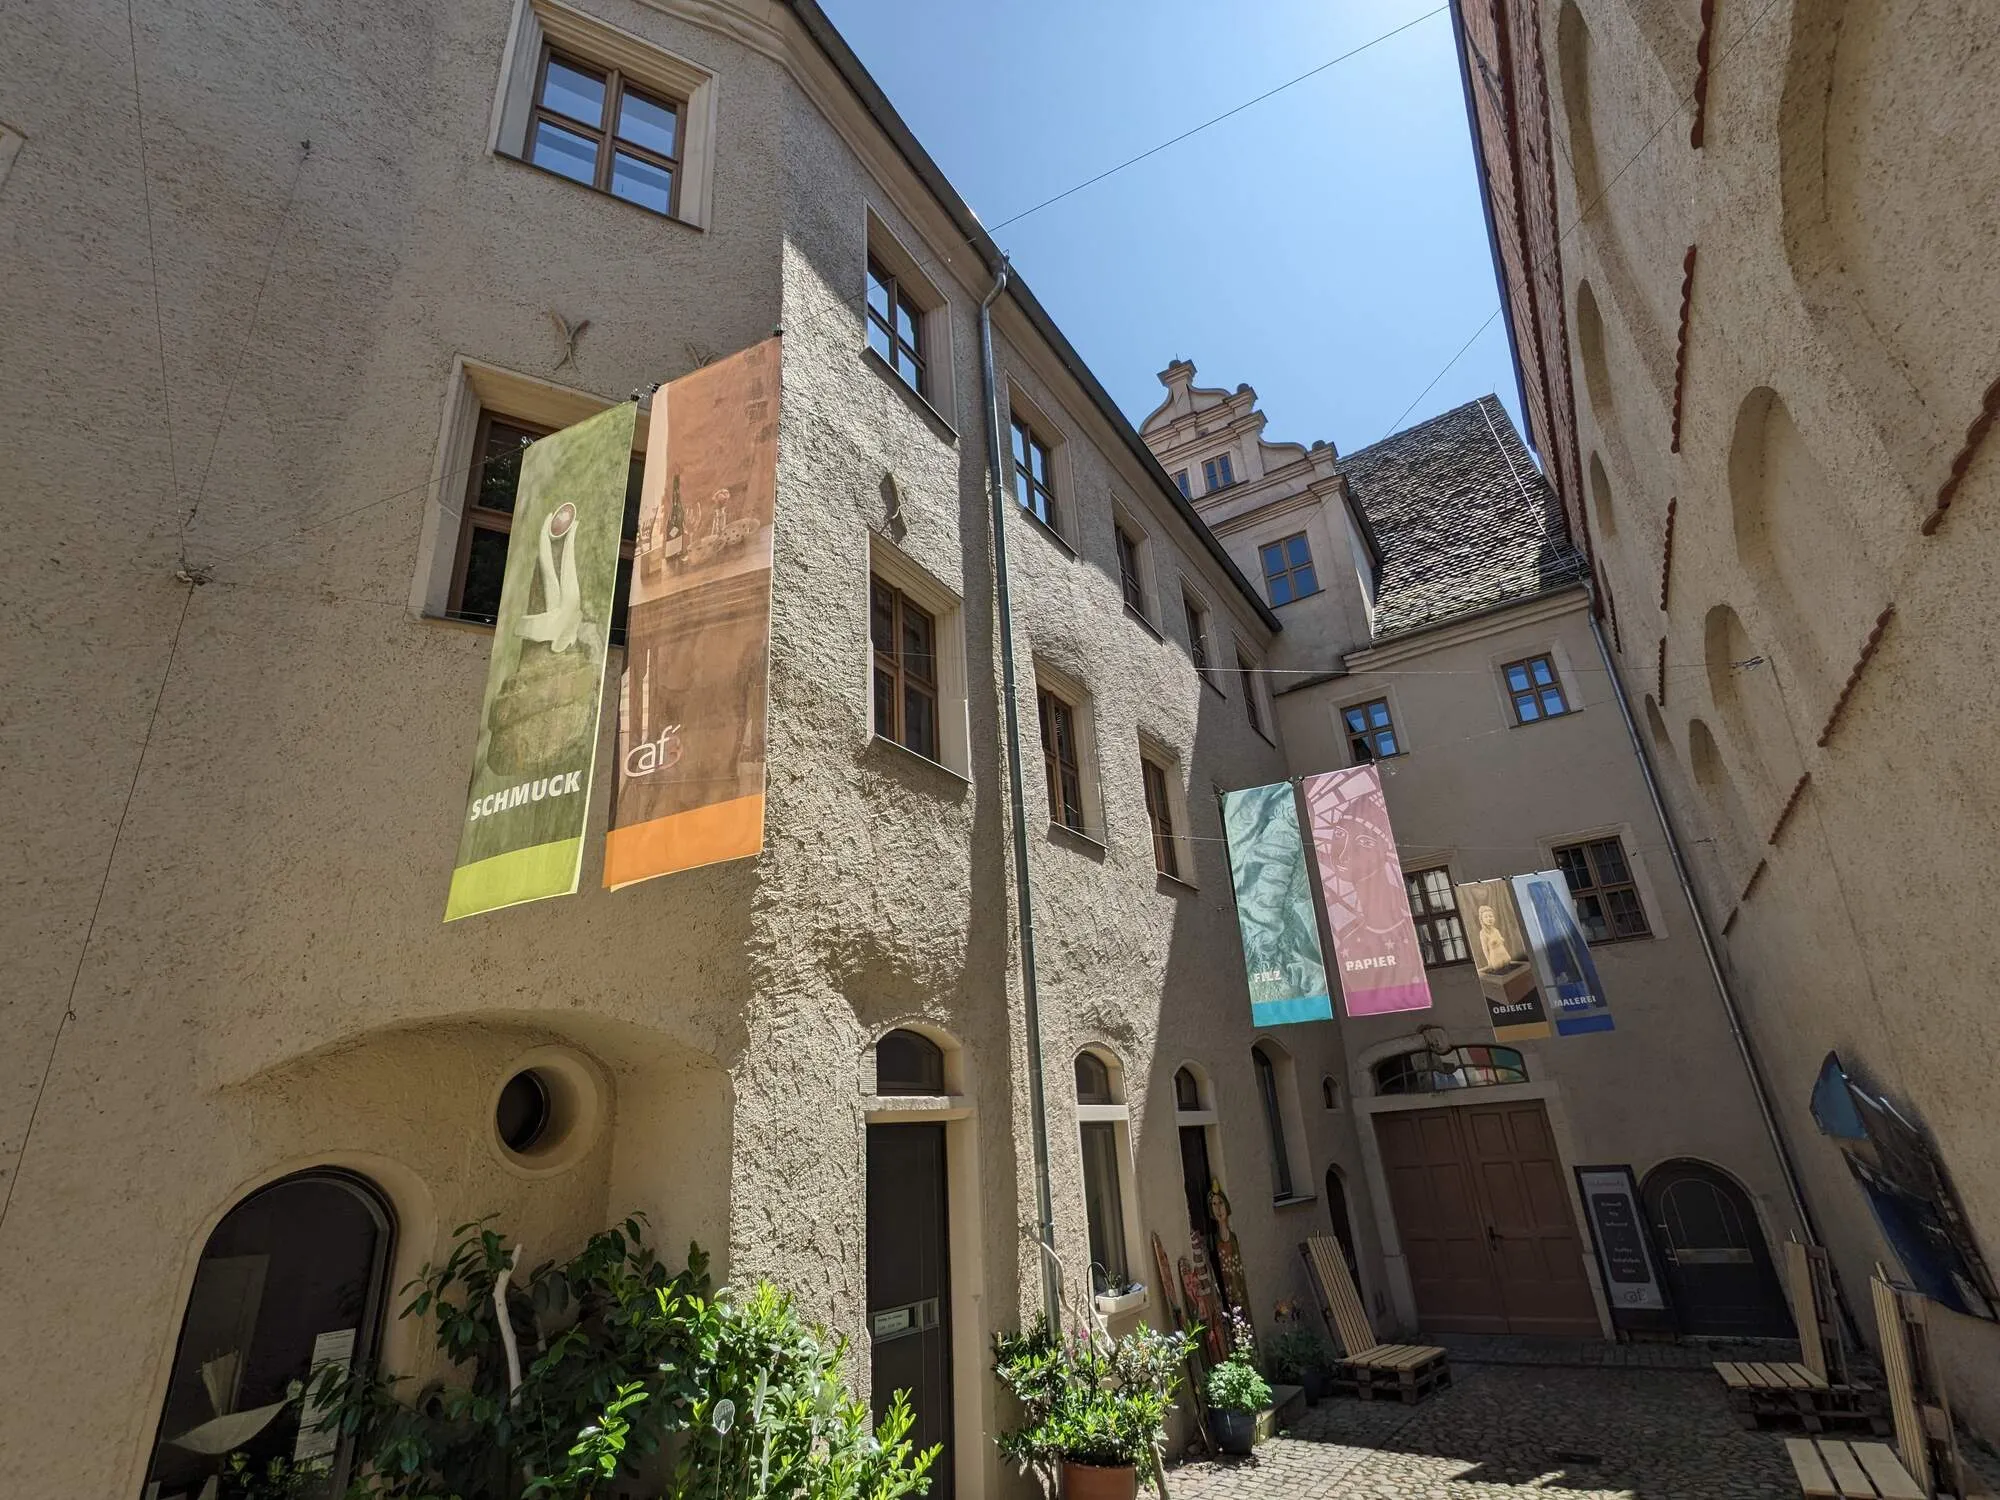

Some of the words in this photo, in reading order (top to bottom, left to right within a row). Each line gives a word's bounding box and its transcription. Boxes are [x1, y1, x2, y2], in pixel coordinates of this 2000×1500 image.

[470, 770, 582, 821] SCHMUCK
[1345, 955, 1397, 972] PAPIER
[1254, 970, 1281, 983] FILZ
[1493, 1002, 1533, 1014] OBJEKTE
[1554, 995, 1596, 1008] MALEREI
